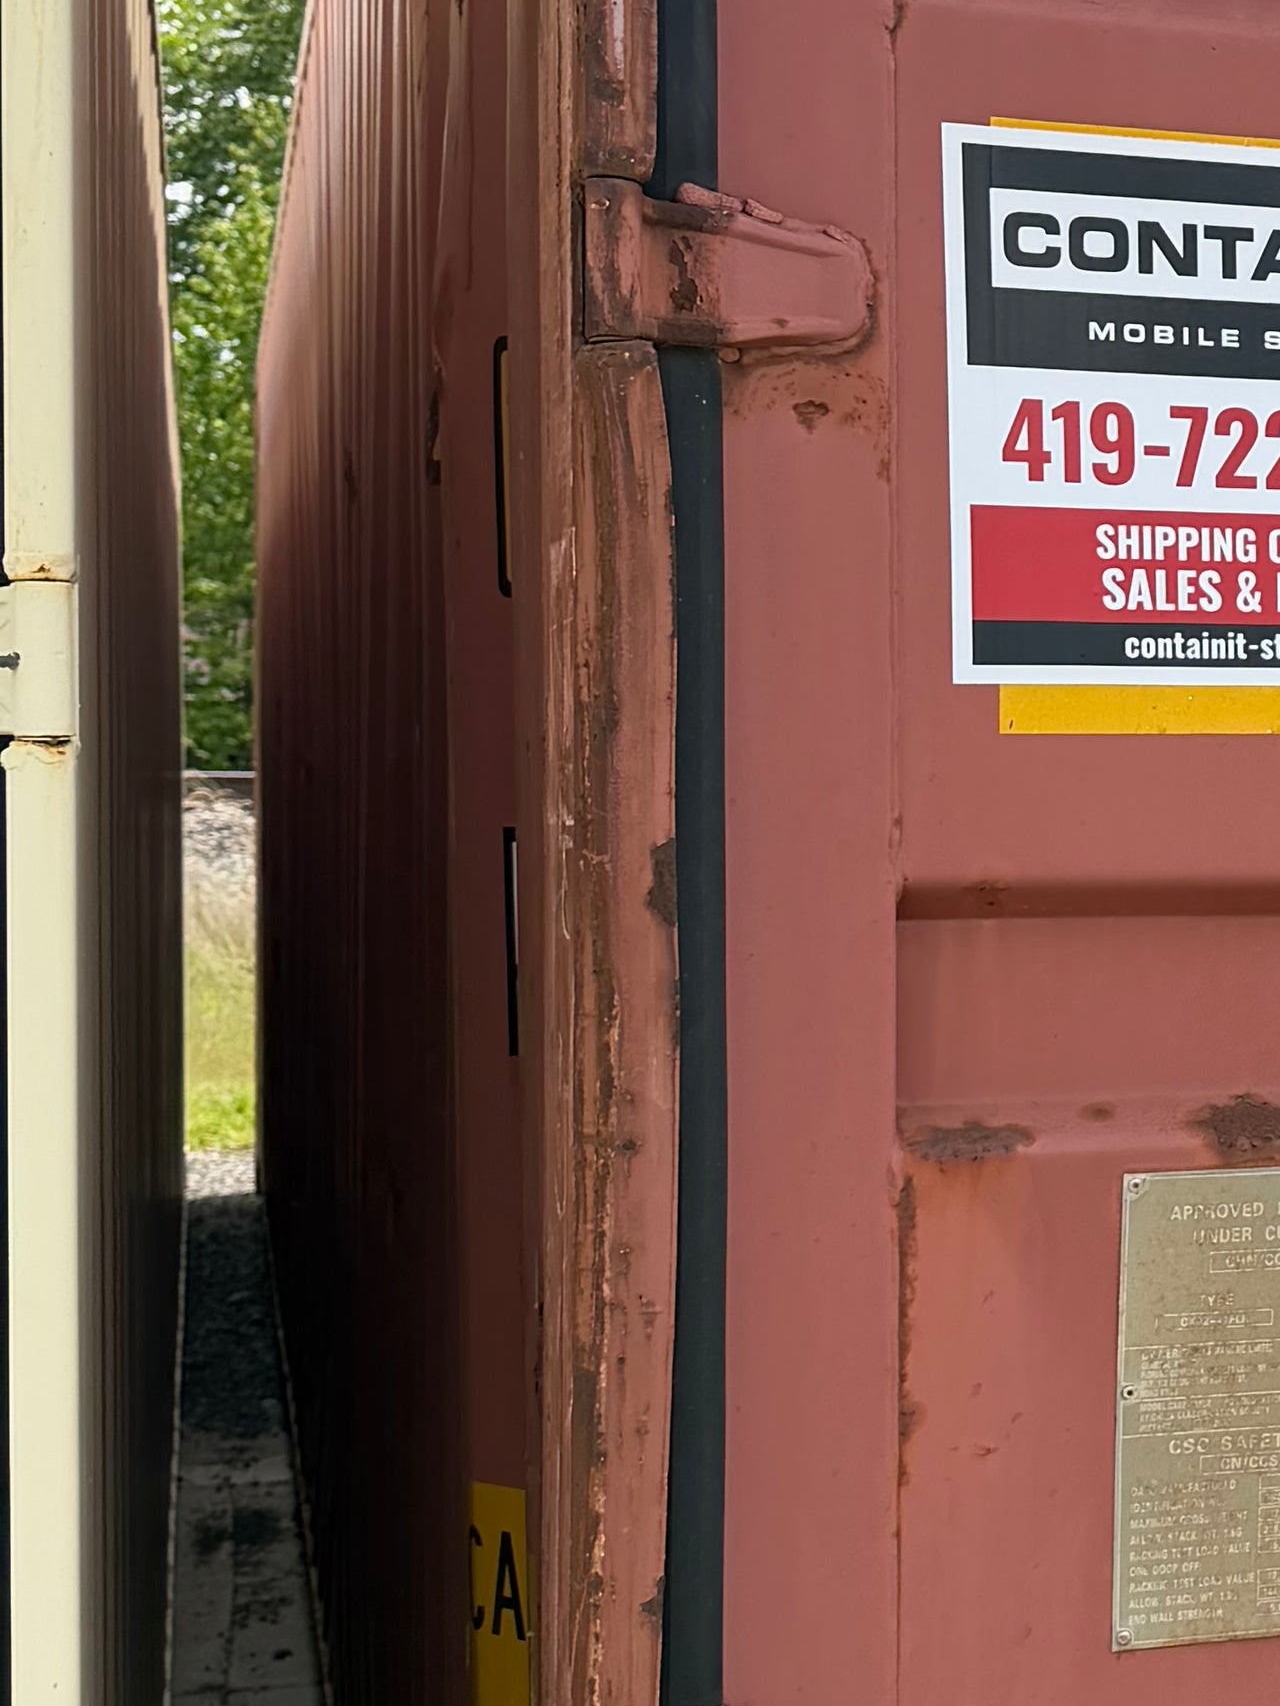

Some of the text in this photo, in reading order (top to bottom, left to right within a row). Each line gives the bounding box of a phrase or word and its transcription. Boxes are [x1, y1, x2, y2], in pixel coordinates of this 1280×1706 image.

[1088, 321, 1240, 348] MOBILE
[1095, 523, 1257, 563] SHIPPING
[1102, 568, 1223, 612] SALES
[1236, 570, 1263, 613] &
[1170, 1202, 1264, 1221] APPROVED
[1193, 1227, 1252, 1245] UNDER
[1167, 1436, 1209, 1455] CSC
